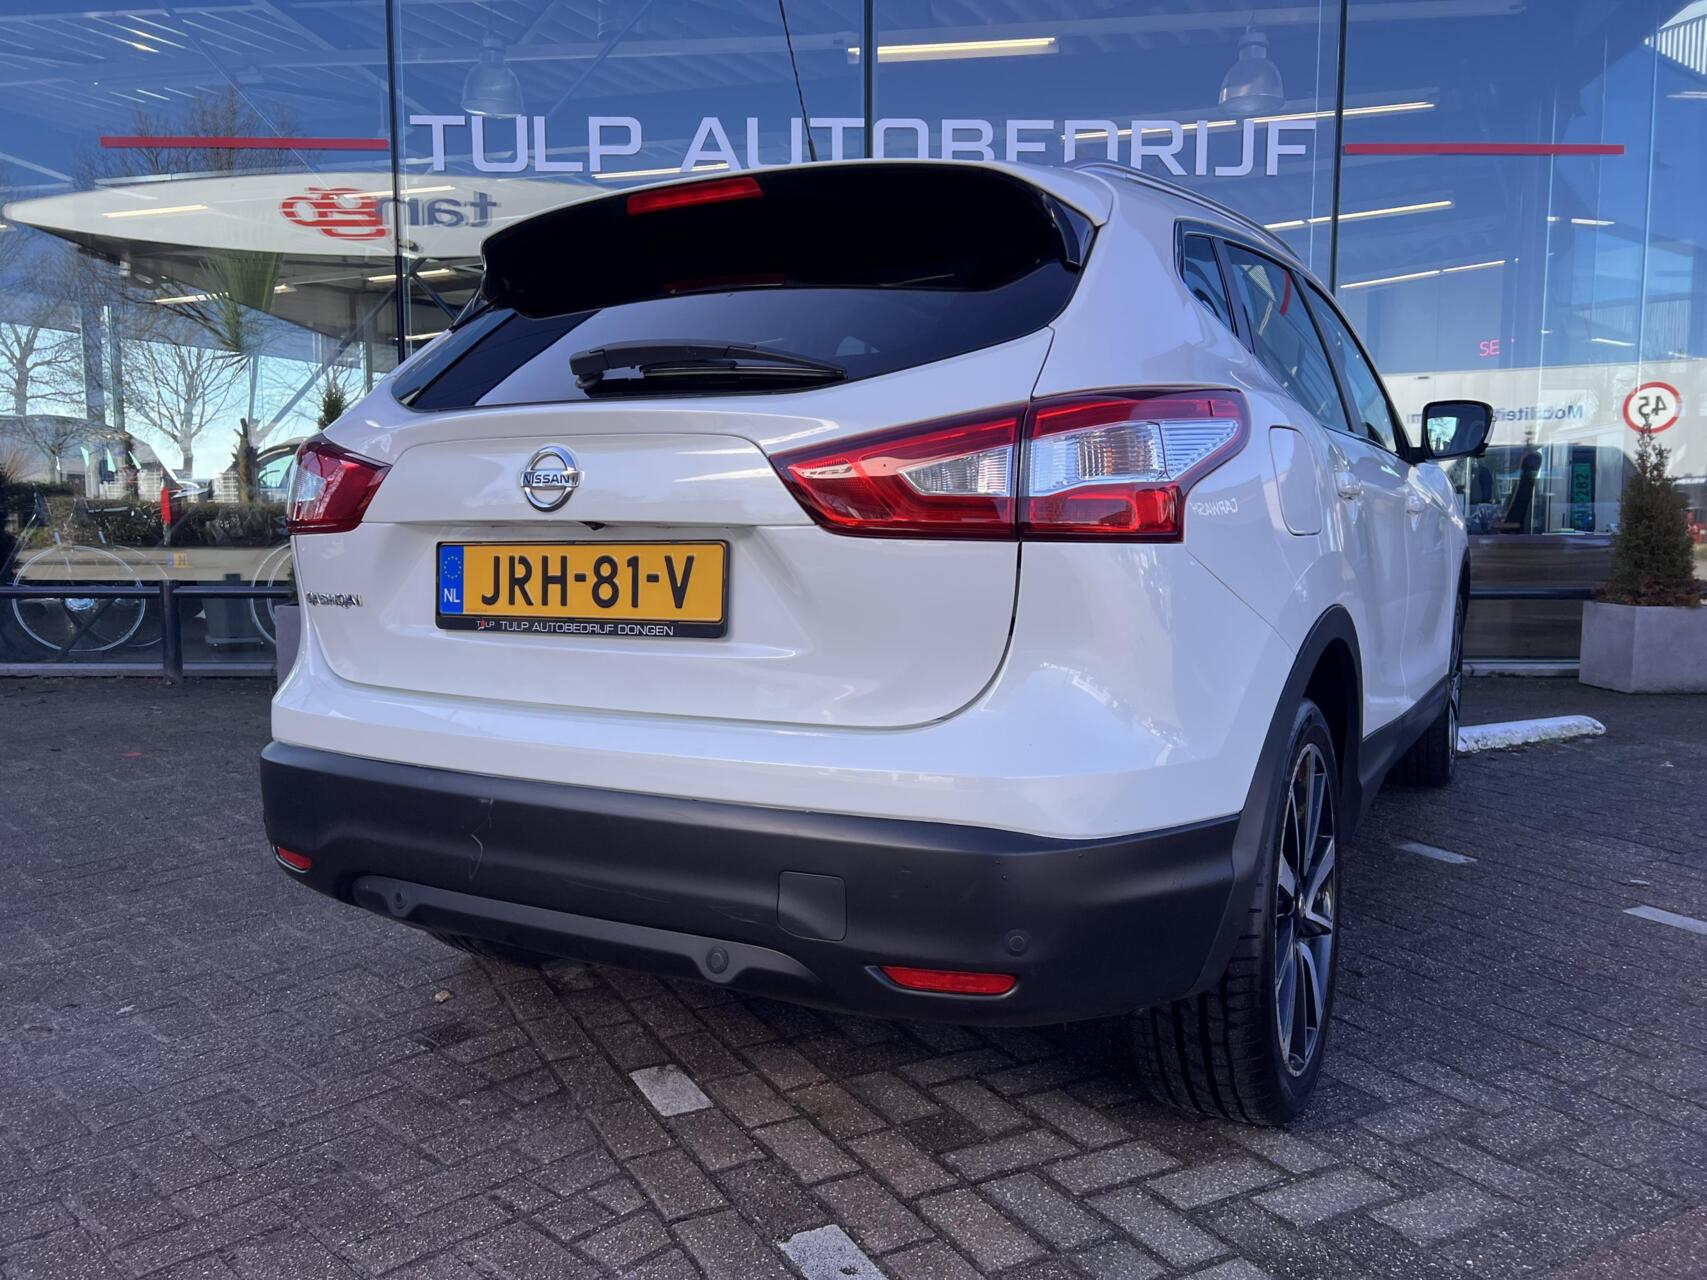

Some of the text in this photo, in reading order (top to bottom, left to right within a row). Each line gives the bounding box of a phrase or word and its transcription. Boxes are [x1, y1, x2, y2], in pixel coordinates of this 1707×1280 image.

[410, 115, 1316, 176] TULP AUTOBEDRIJF
[524, 472, 570, 485] NISSAN
[481, 554, 695, 609] JRH-81-V
[443, 587, 461, 604] NL
[500, 620, 674, 636] TULP AUTOBEDRIJF DONGEN
